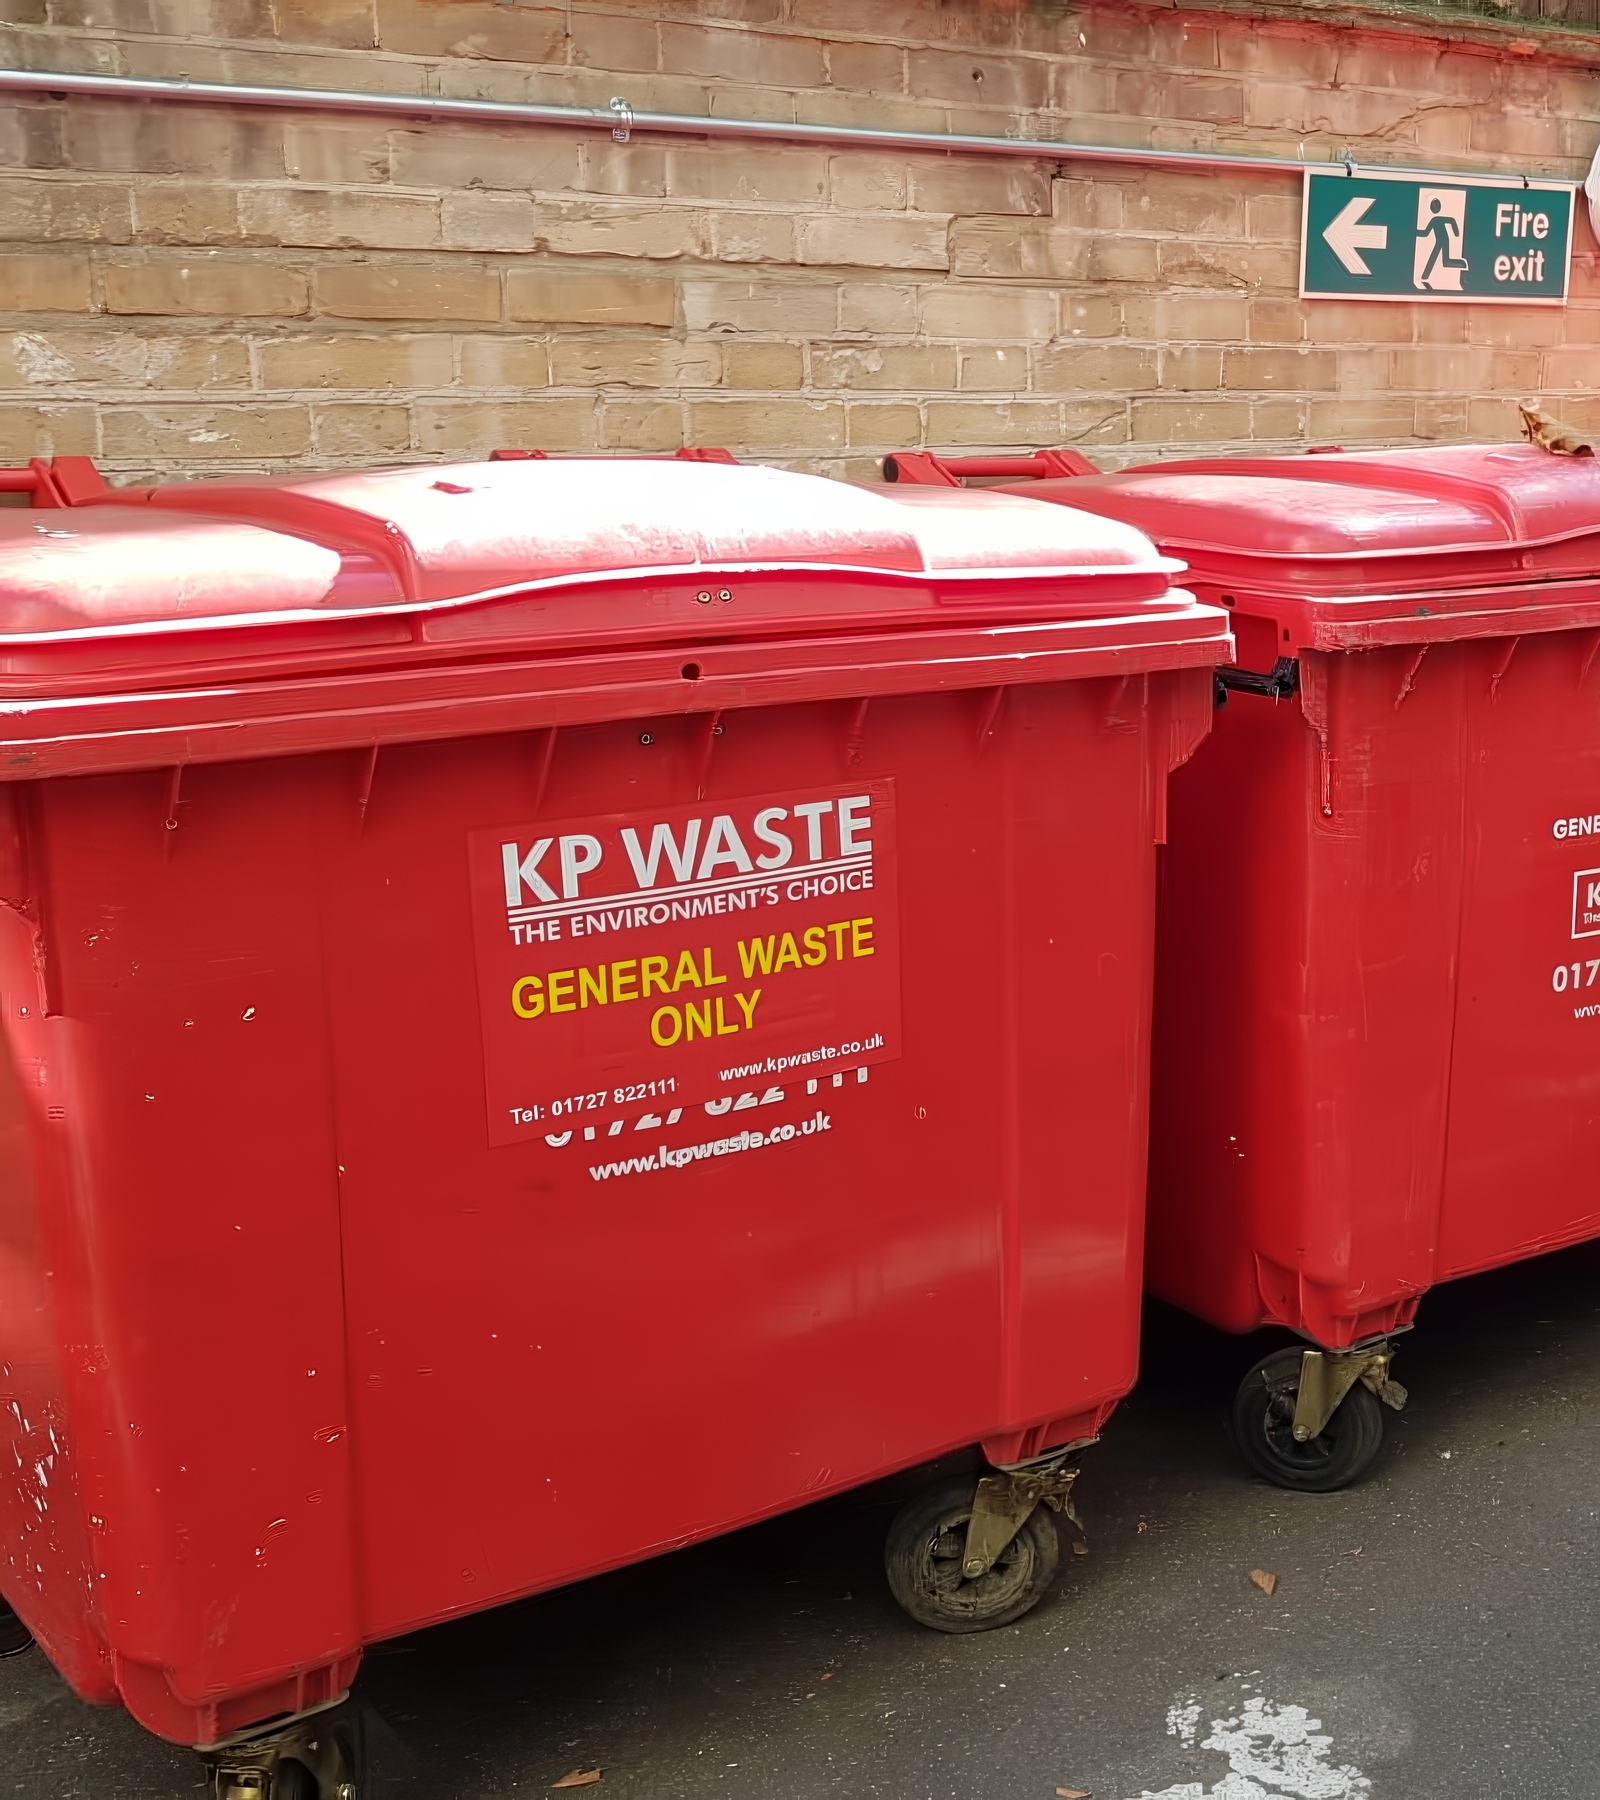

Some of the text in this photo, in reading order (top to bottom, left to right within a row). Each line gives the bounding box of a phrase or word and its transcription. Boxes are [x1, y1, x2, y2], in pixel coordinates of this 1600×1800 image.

[1495, 202, 1549, 239] Fire
[1493, 249, 1545, 282] exit
[502, 795, 872, 907] KP WASTE
[509, 870, 874, 945] THE ENVIRONMENT'S CHOICE
[511, 918, 875, 1019] GENERAL WASTE
[650, 989, 762, 1047] ONLY
[718, 1033, 884, 1081] www.kpwaste.co.uk
[510, 1105, 545, 1125] Tel:
[551, 1092, 607, 1117] 01727
[613, 1078, 677, 1104] 822111
[589, 1111, 832, 1181] www.kpwaste.co.uk
